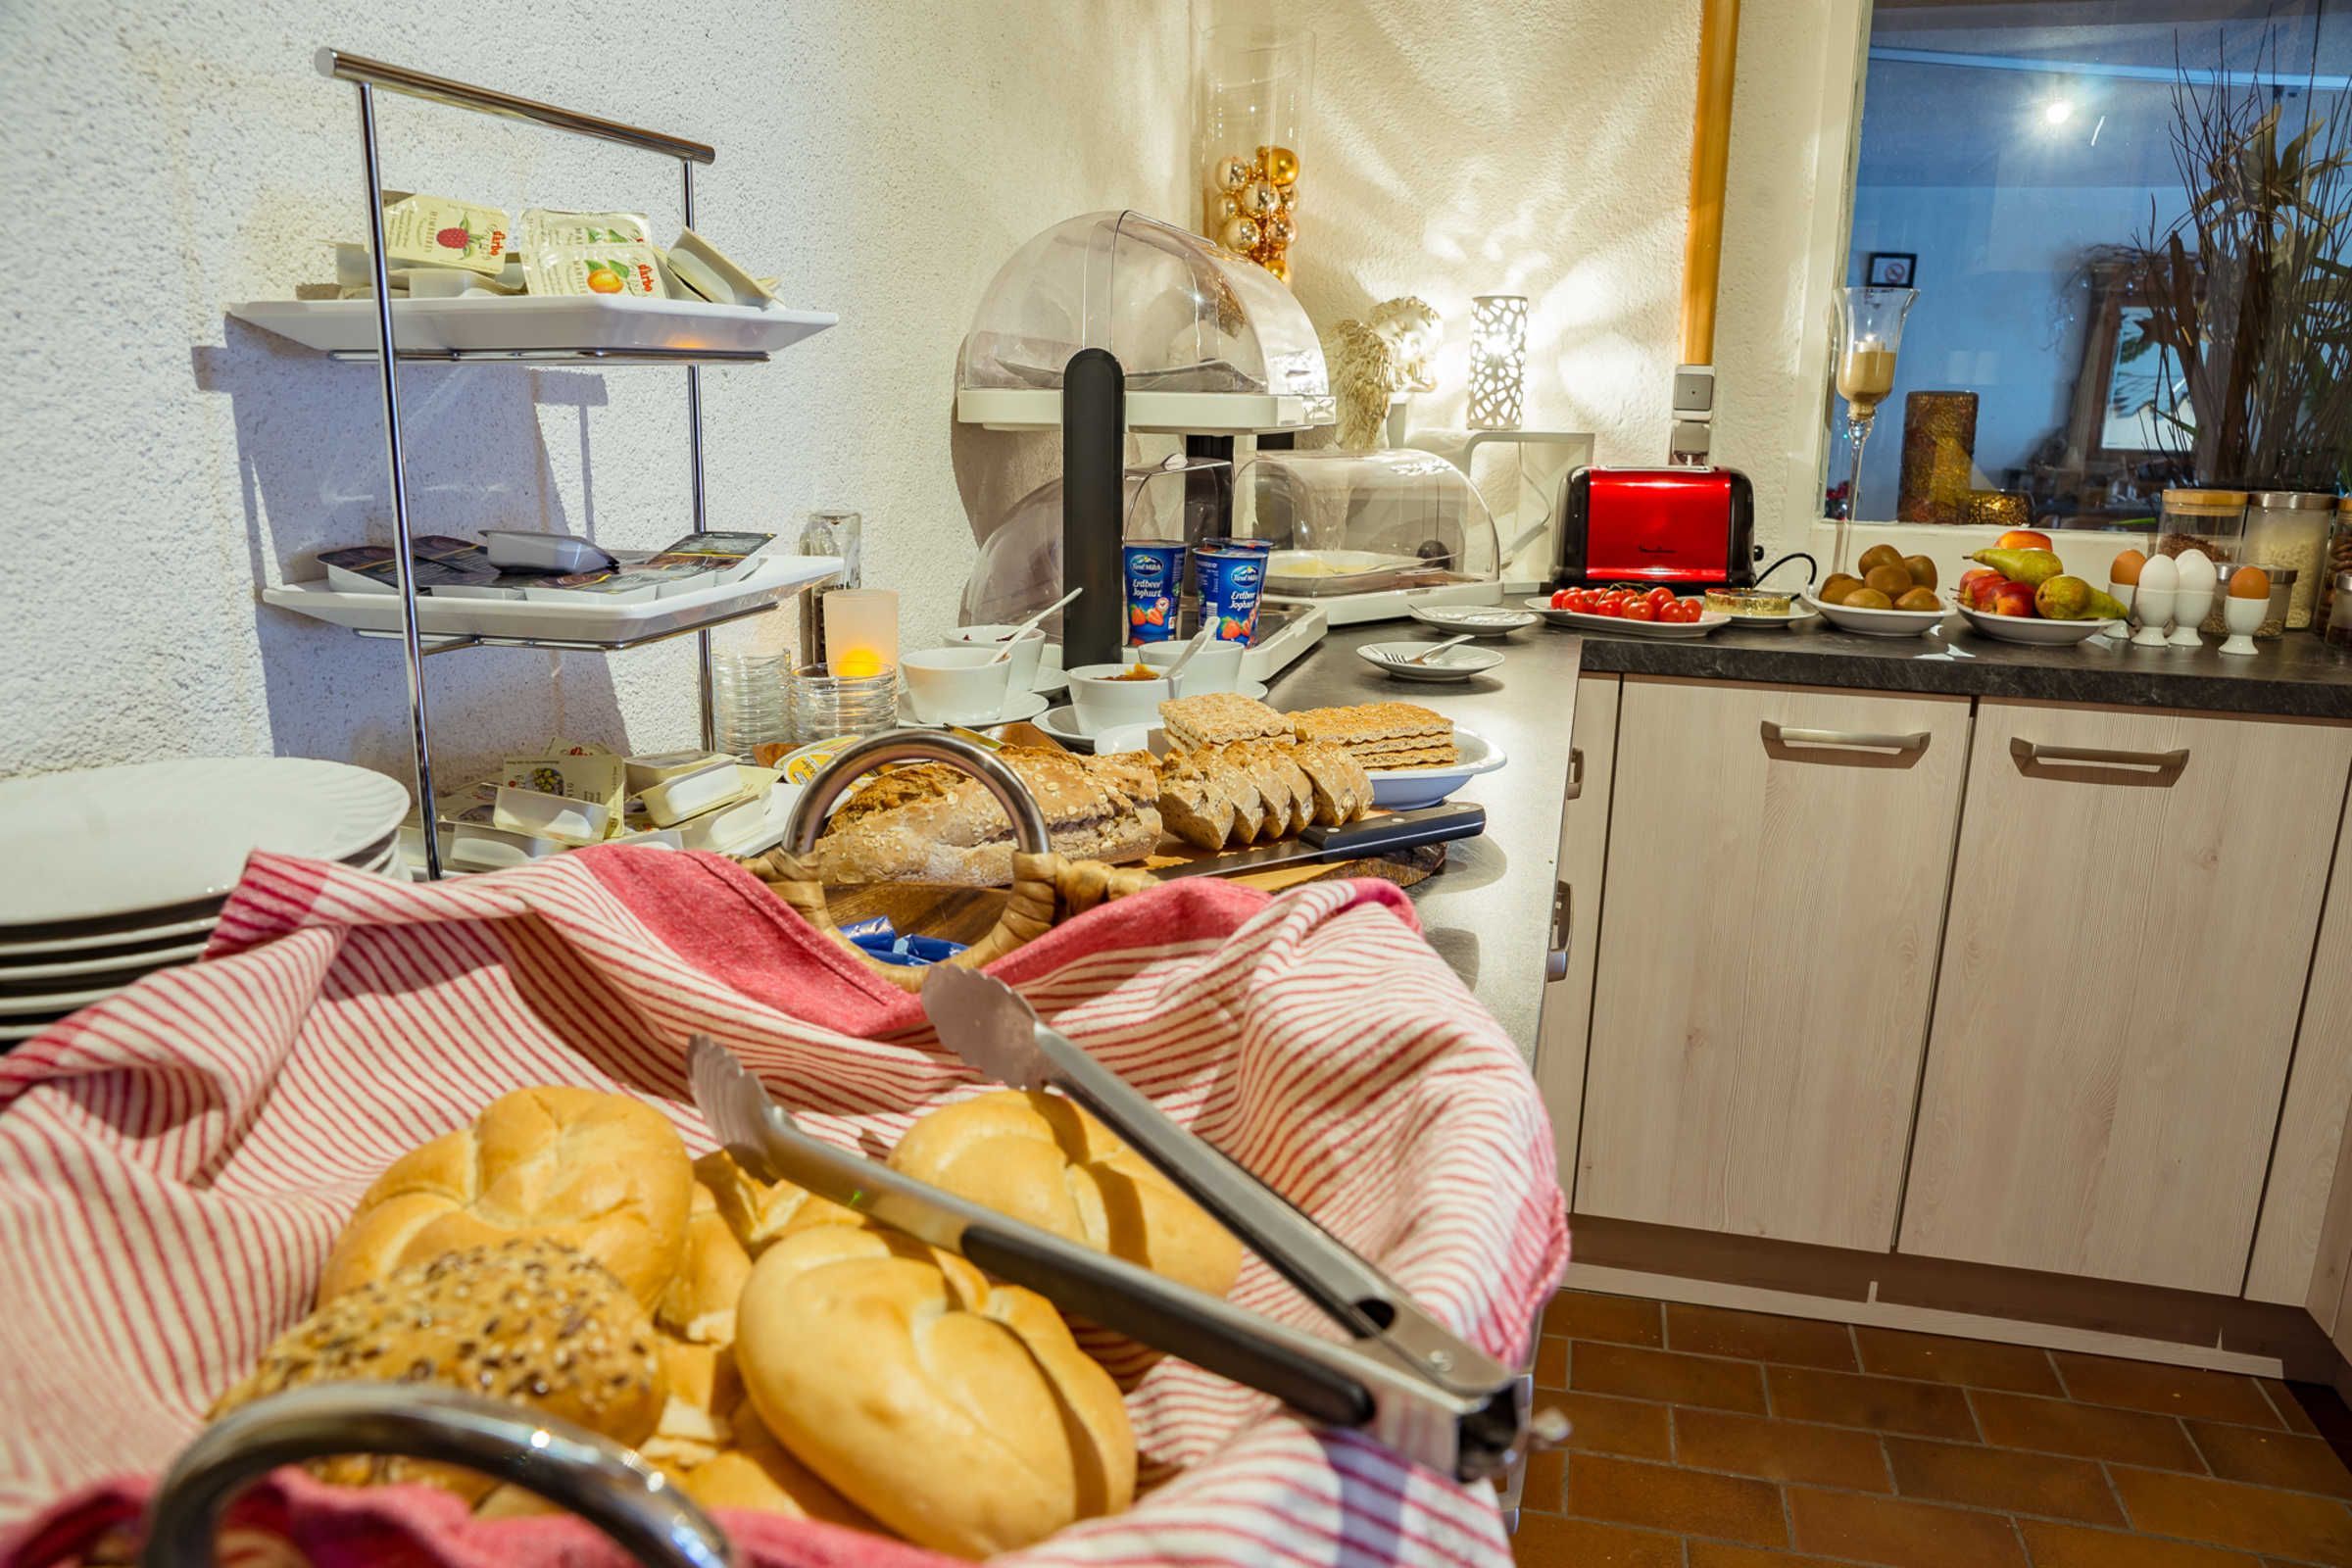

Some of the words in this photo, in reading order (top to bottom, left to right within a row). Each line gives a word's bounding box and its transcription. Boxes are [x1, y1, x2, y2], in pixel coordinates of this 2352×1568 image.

[490, 229, 506, 256] darbo
[637, 264, 654, 293] darbo
[1133, 579, 1163, 588] Erdbeer
[1133, 588, 1162, 599] Joghurt
